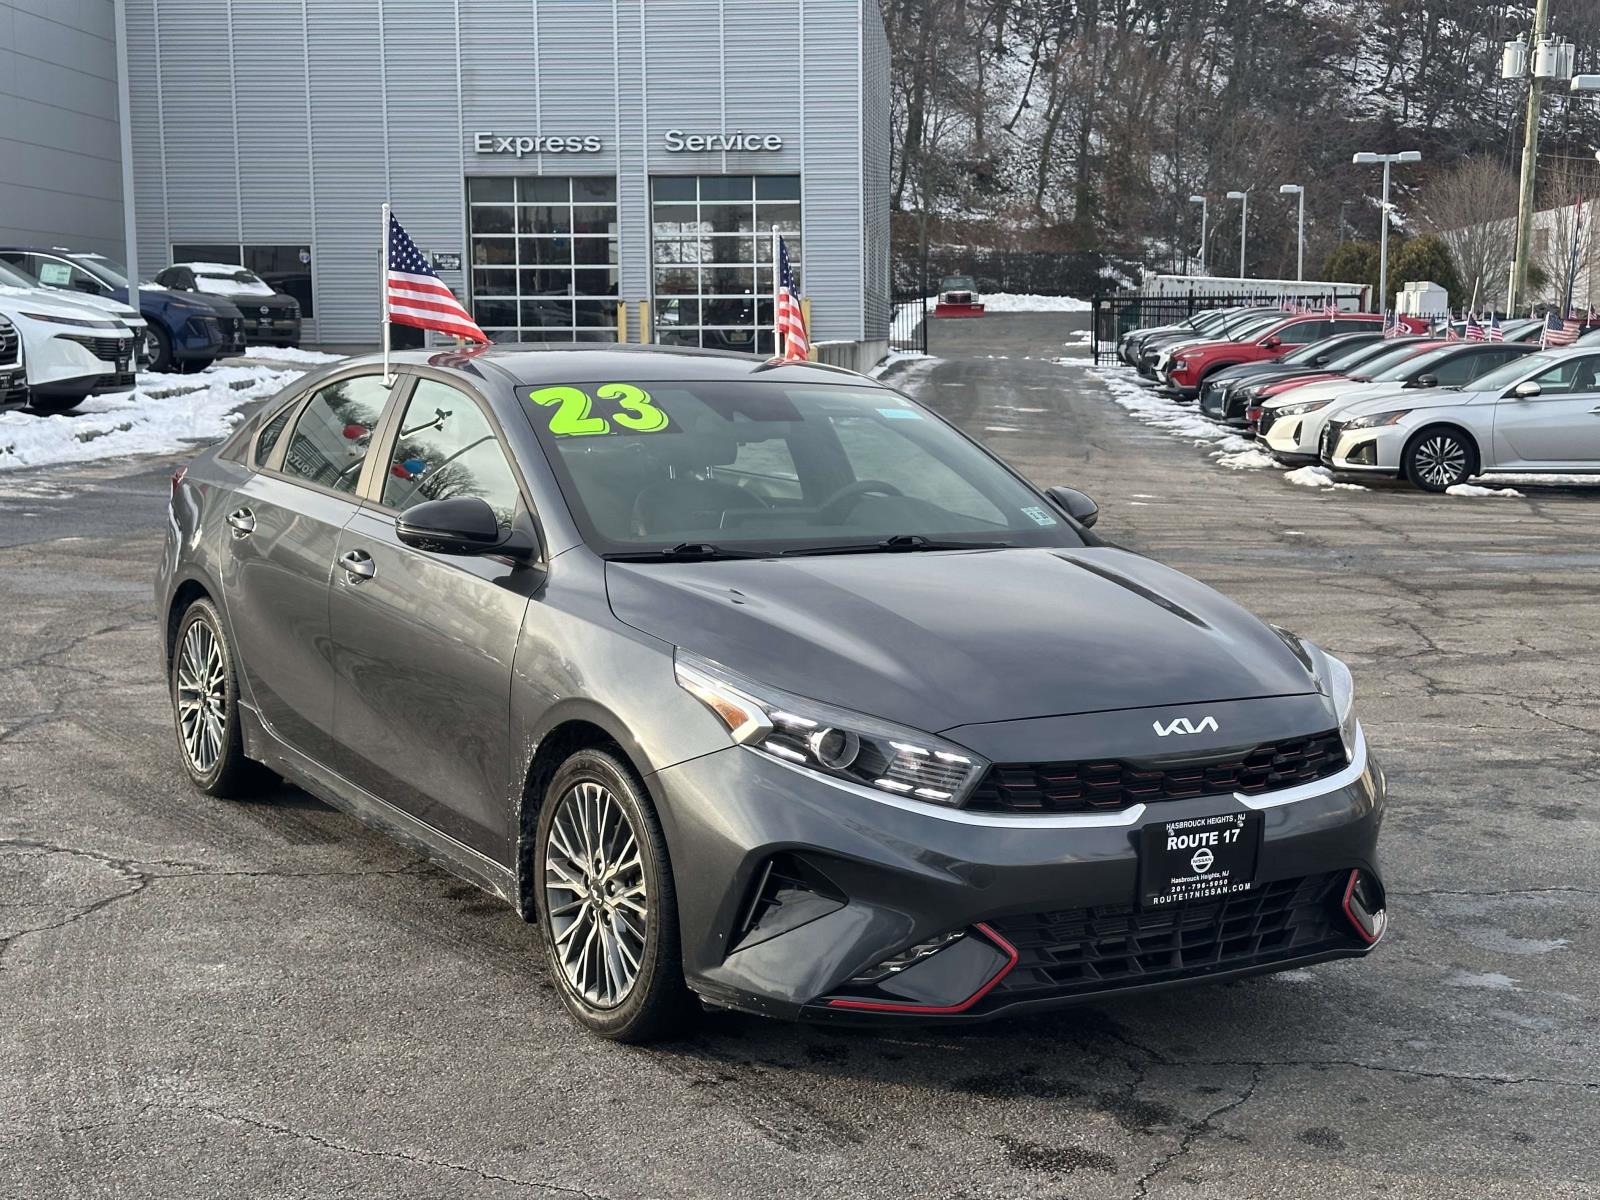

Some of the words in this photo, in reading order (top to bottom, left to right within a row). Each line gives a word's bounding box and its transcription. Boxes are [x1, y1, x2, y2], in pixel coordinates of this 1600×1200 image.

[474, 131, 601, 157] Express
[664, 129, 783, 152] Service
[529, 383, 669, 436] 23
[1152, 716, 1219, 737] KIA
[1166, 819, 1206, 831] HASBROUCK
[1237, 813, 1246, 821] NJ
[1167, 831, 1219, 851] ROUTE
[1223, 828, 1241, 843] 17
[1192, 856, 1213, 865] NISSAN
[1171, 875, 1200, 884] Hasbrouck
[1153, 882, 1251, 905] ROUTE17NISSAN.COM
